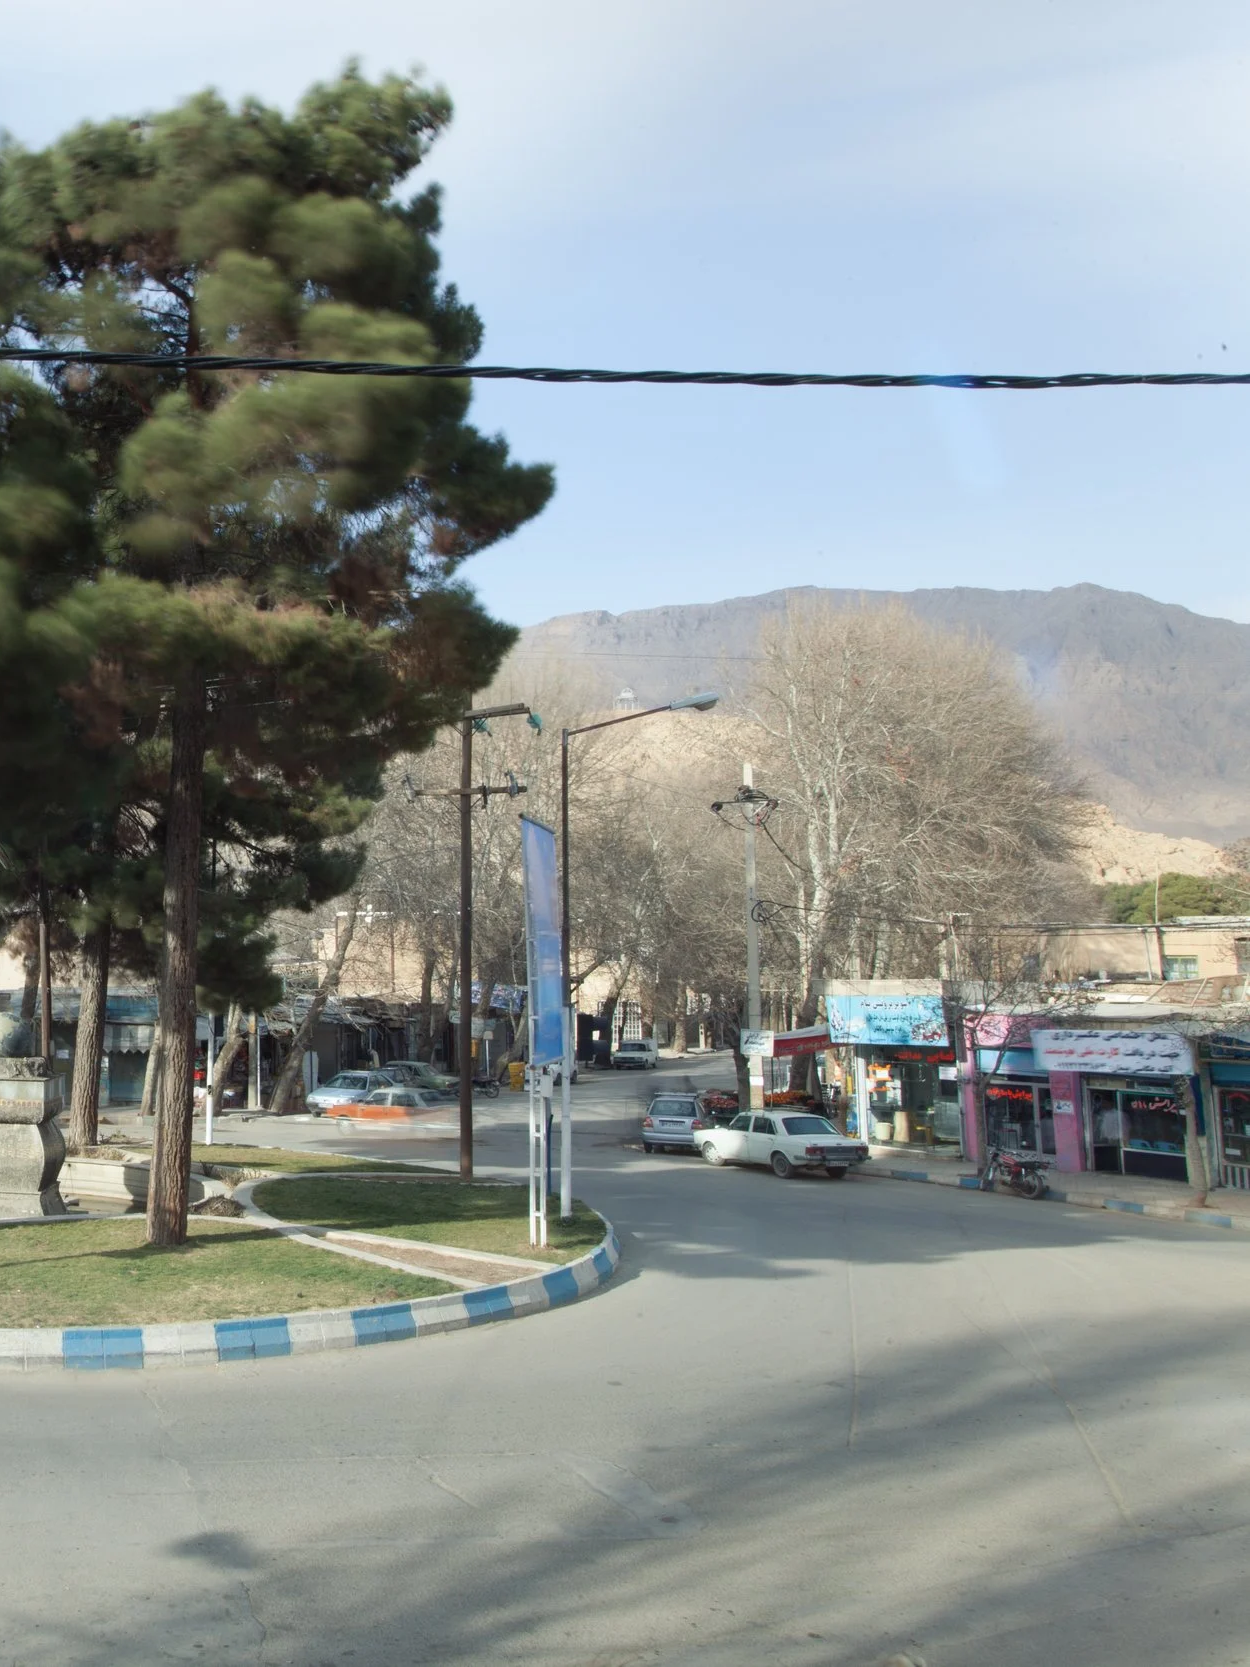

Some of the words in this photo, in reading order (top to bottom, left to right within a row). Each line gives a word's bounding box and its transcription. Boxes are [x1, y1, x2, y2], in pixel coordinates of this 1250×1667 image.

[1077, 1047, 1095, 1058] ملی
[1097, 1047, 1119, 1059] کارت
[1149, 1096, 1178, 1115] پیرایش
